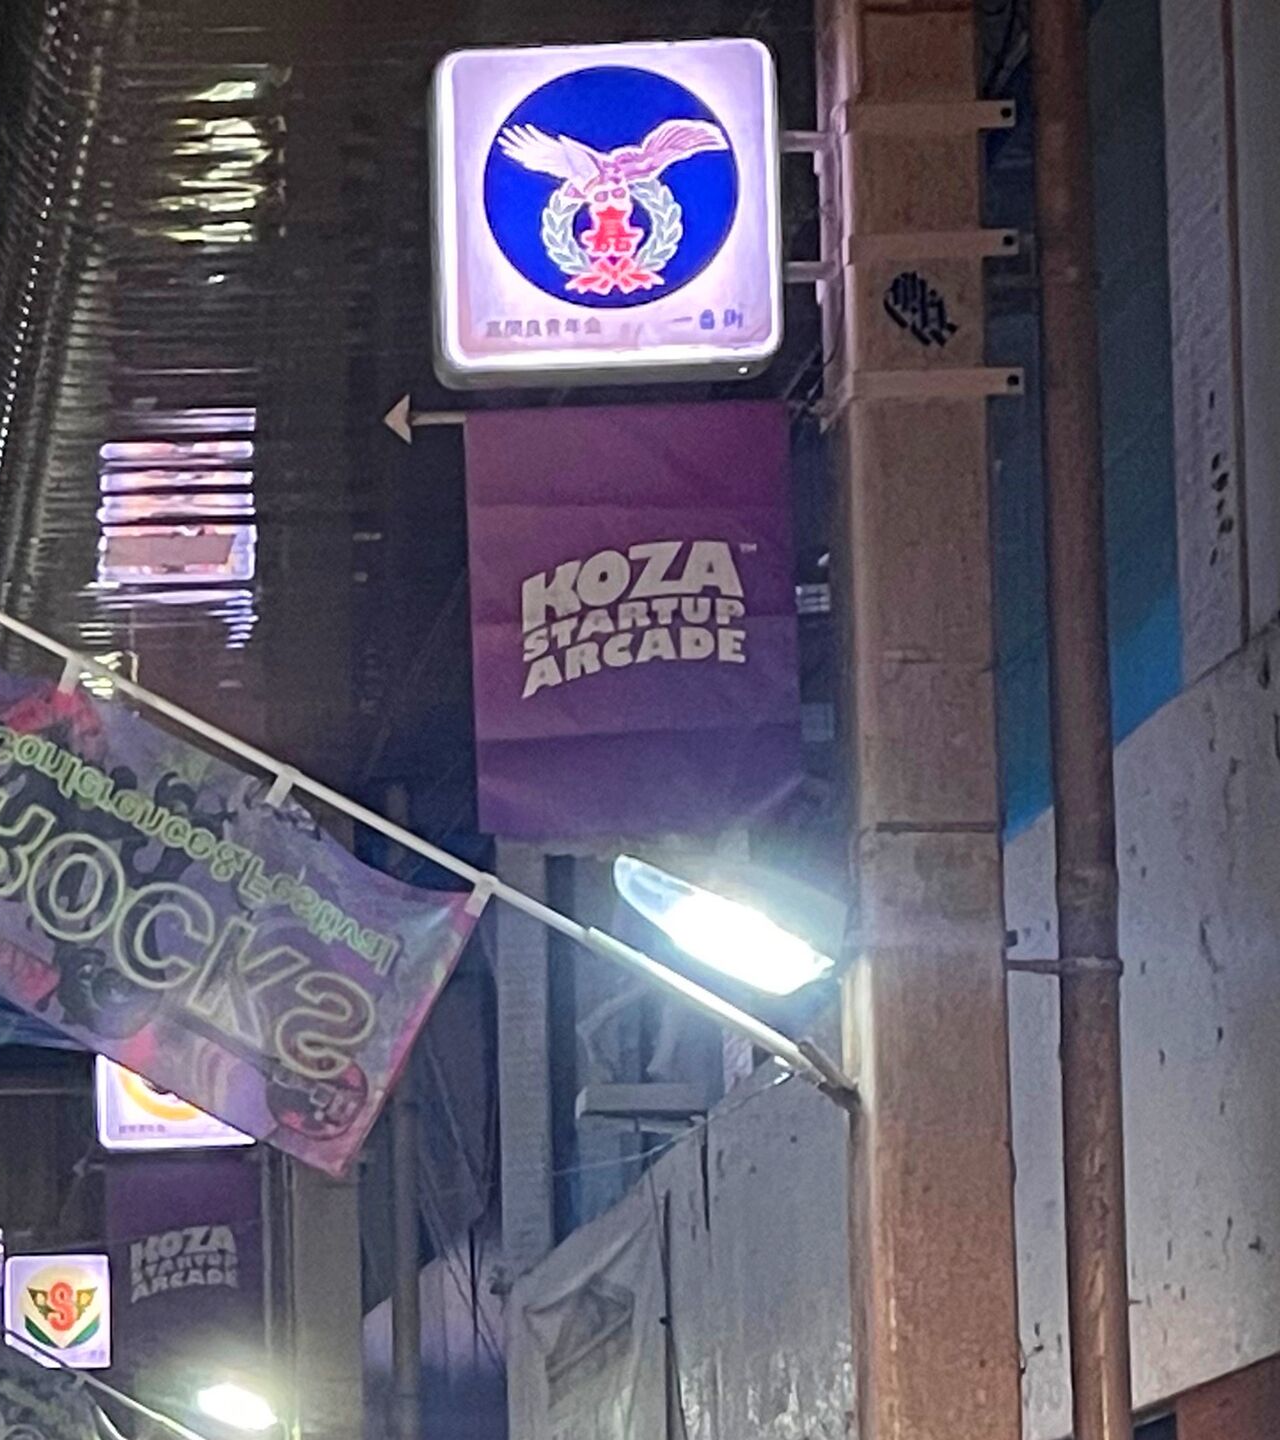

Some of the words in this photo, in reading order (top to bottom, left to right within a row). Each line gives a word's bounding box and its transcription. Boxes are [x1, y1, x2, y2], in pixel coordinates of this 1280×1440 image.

[521, 540, 744, 632] KOZA
[521, 627, 747, 699] ARCADE
[522, 596, 747, 662] STARTUP
[131, 1225, 237, 1266] KOZA
